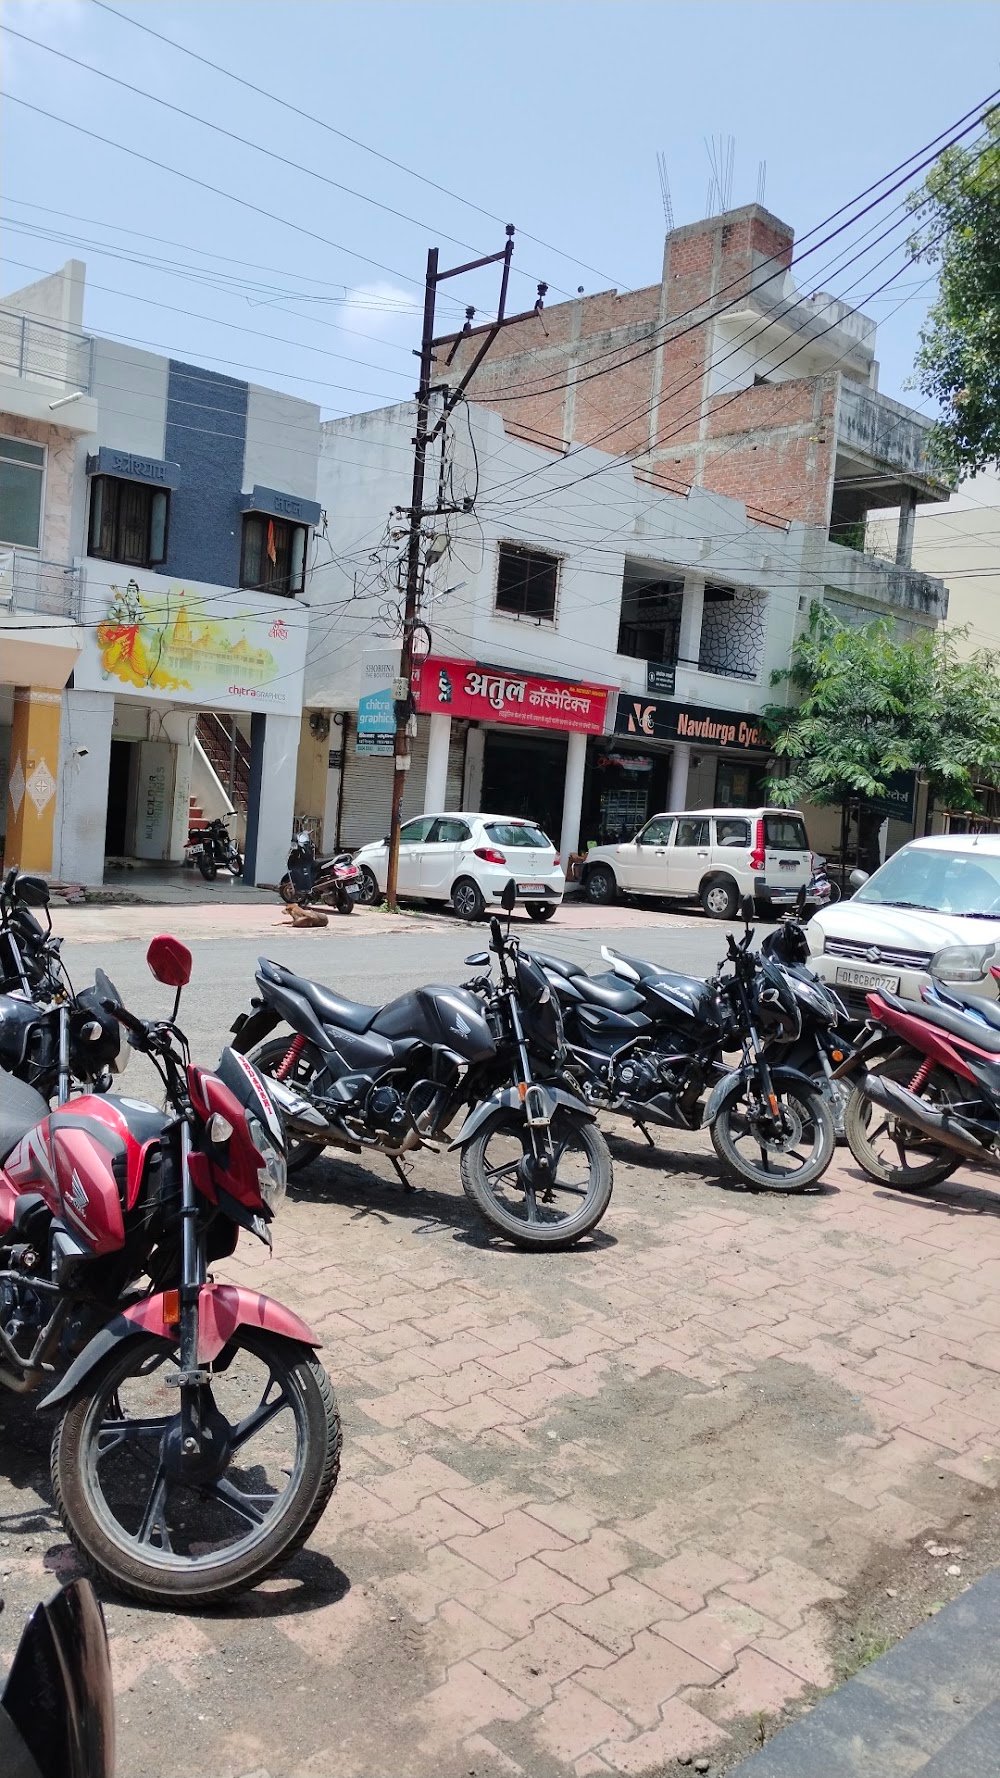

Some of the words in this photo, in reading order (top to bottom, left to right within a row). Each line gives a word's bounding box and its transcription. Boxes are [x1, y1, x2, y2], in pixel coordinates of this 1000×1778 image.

[366, 698, 390, 710] chitra
[464, 672, 527, 710] अतुल
[677, 713, 736, 746] Navdurga
[738, 721, 767, 748] Cyc
